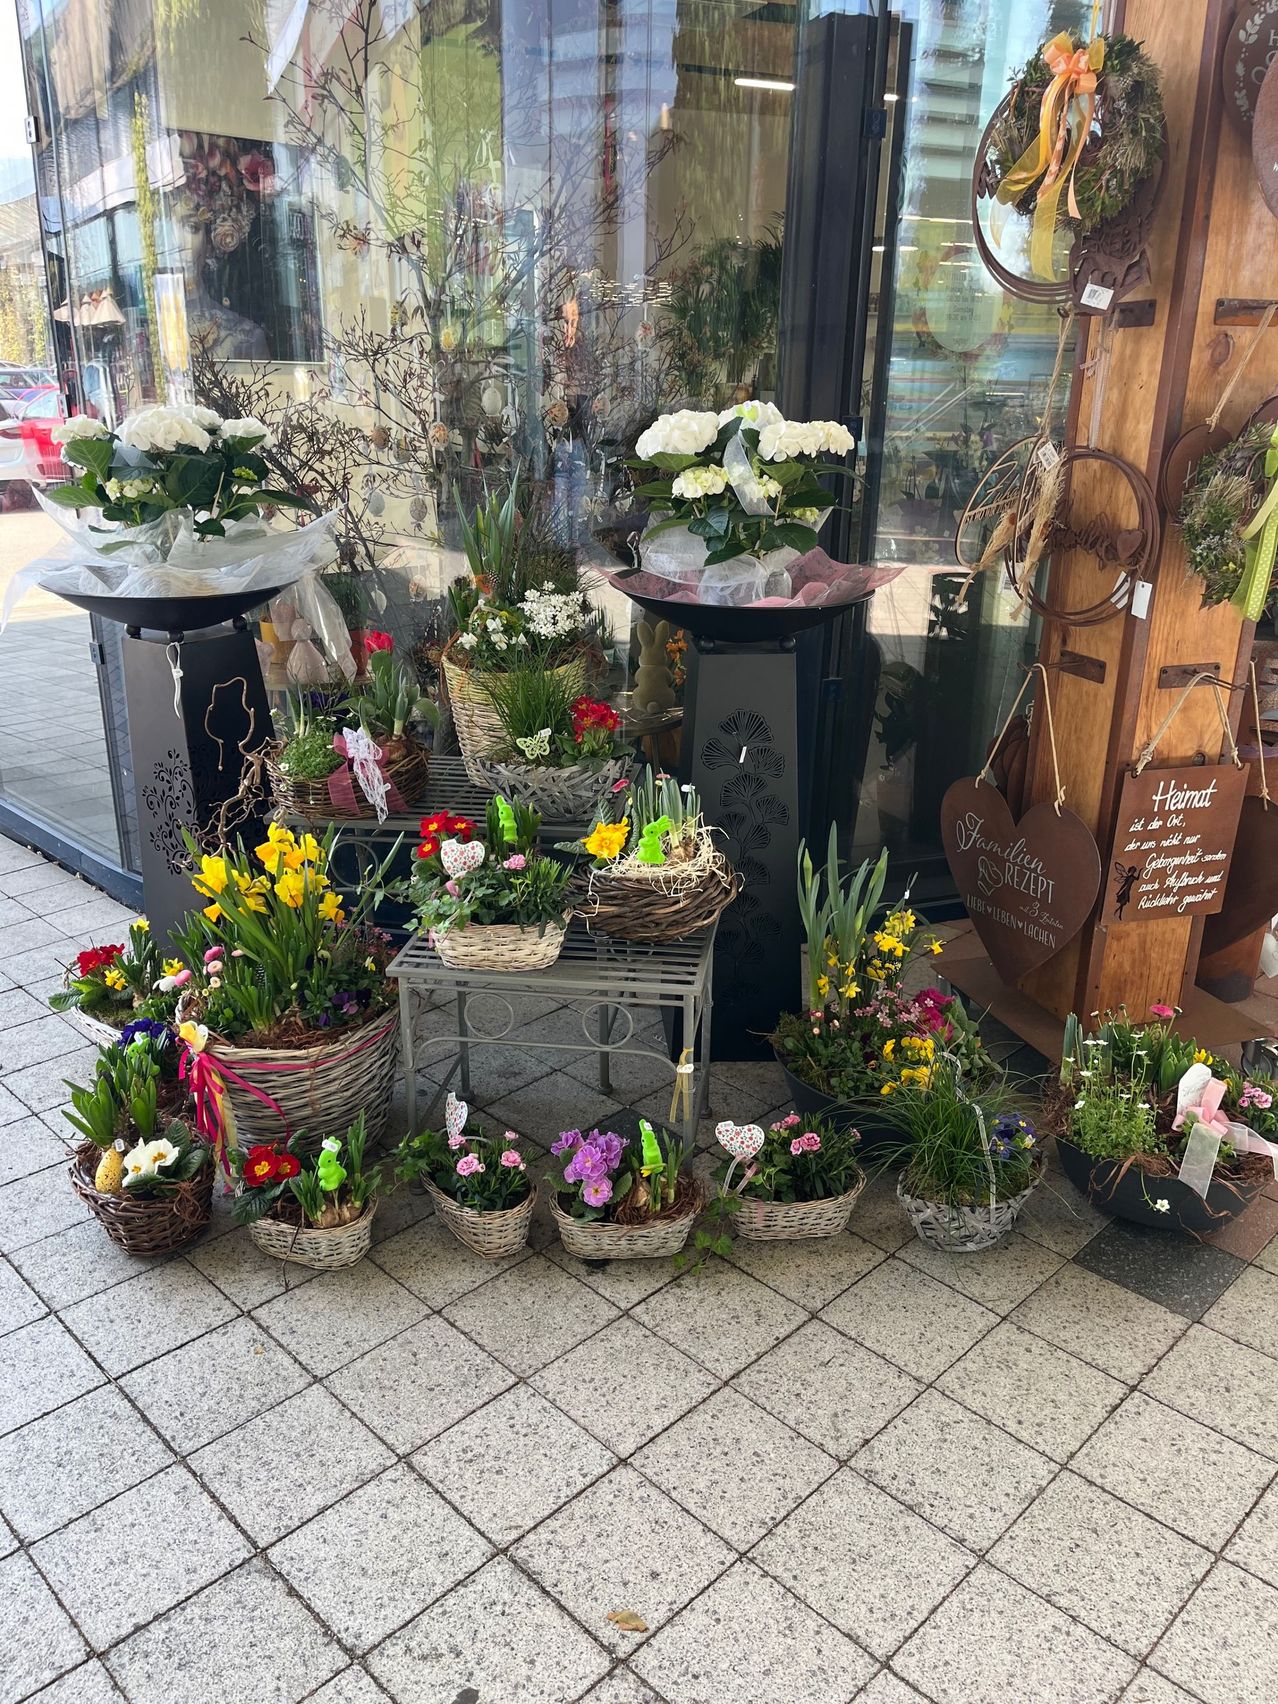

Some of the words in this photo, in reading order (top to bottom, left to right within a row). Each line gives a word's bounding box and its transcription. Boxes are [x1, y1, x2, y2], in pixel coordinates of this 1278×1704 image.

[1152, 779, 1218, 812] Heimat
[1129, 817, 1145, 832] ist
[1147, 816, 1163, 830] der
[1166, 813, 1186, 828] Ort,
[956, 812, 1047, 874] Familien
[1124, 838, 1140, 852] der
[1140, 842, 1156, 850] uns
[1160, 832, 1181, 847] nicht
[1183, 834, 1201, 845] nur
[1142, 847, 1203, 879] Geborgenheit
[1005, 862, 1055, 904] REZEPT
[1138, 879, 1160, 892] auch
[1204, 870, 1224, 883] und
[966, 893, 986, 914] LIEBE
[992, 906, 1017, 929] LEBEN
[1023, 921, 1056, 949] LACHEN
[1029, 901, 1040, 917] 3
